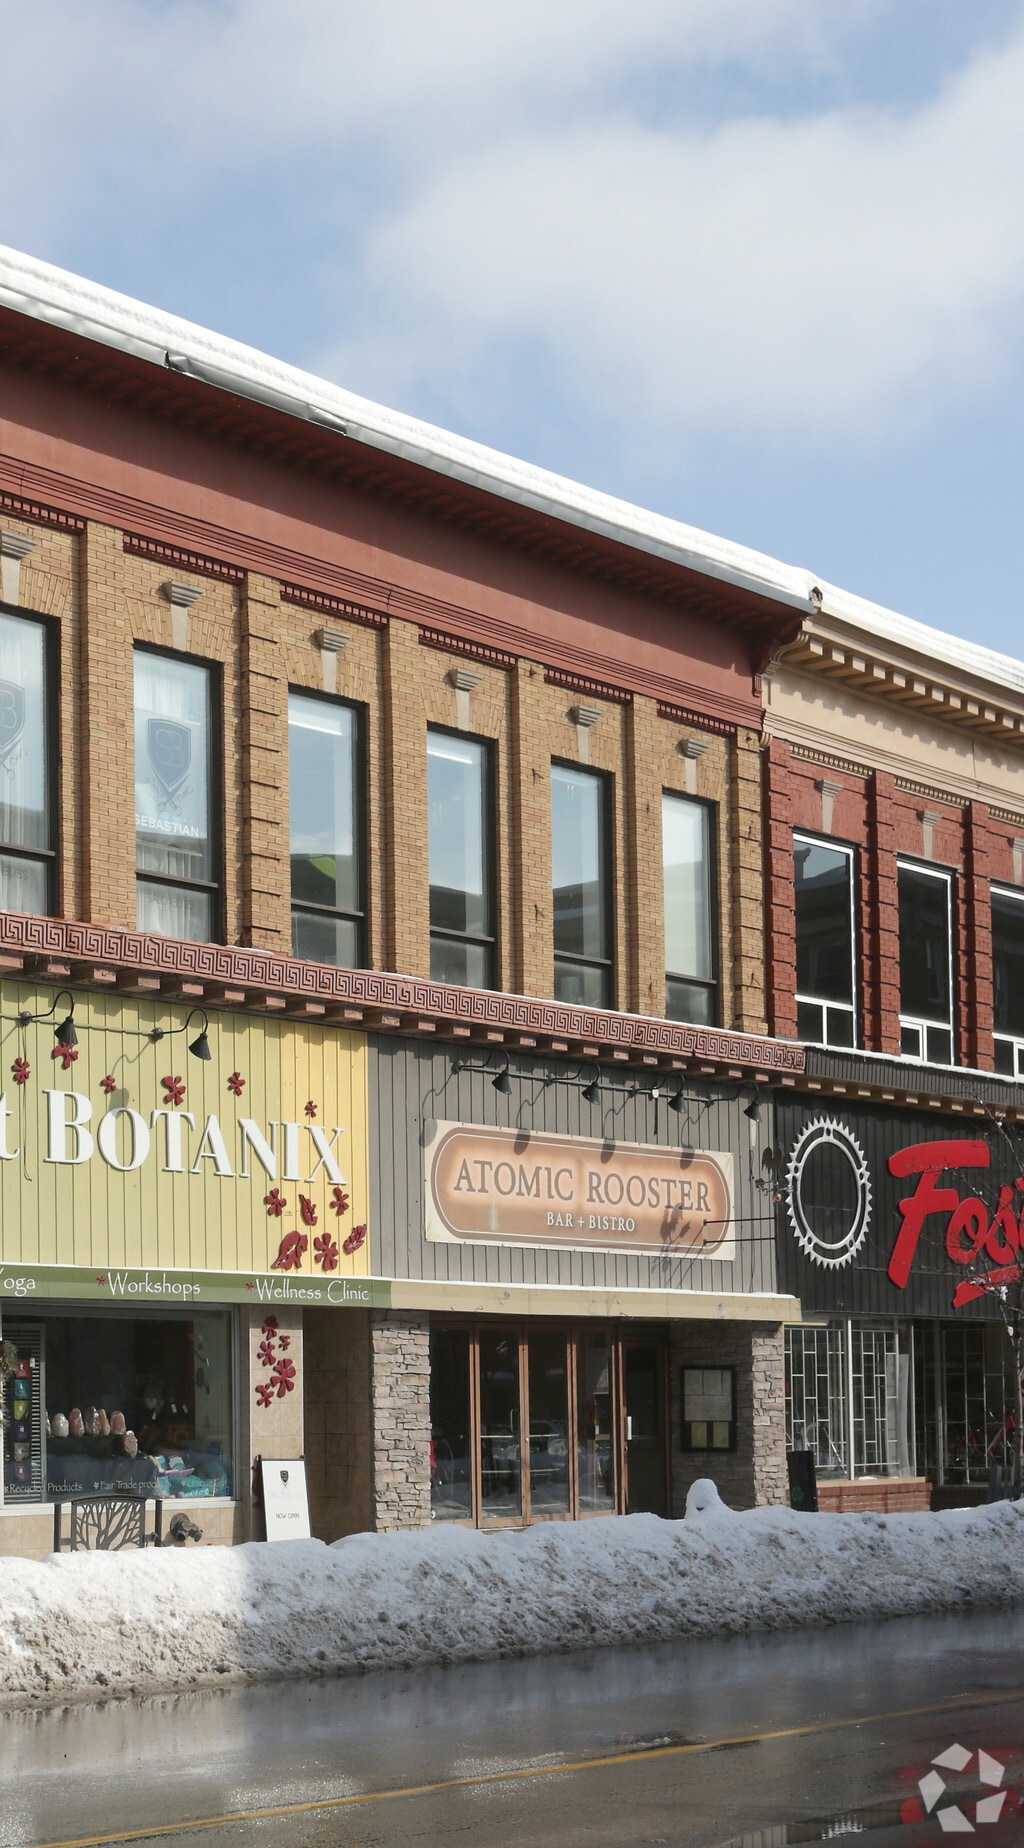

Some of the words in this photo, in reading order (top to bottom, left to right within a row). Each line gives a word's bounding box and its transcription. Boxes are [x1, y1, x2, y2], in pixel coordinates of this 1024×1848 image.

[135, 813, 200, 837] SEBASTIAN
[42, 1088, 349, 1185] BOTANIX
[453, 1157, 575, 1201] ATOMIC
[586, 1170, 712, 1212] ROOSTER
[546, 1211, 574, 1227] BAR
[588, 1215, 636, 1232] BISTRO
[107, 1272, 201, 1301] Workshops
[255, 1278, 322, 1301] Wellness
[327, 1279, 370, 1303] Clinic
[47, 1478, 83, 1493] Products
[115, 1479, 138, 1490] Trade
